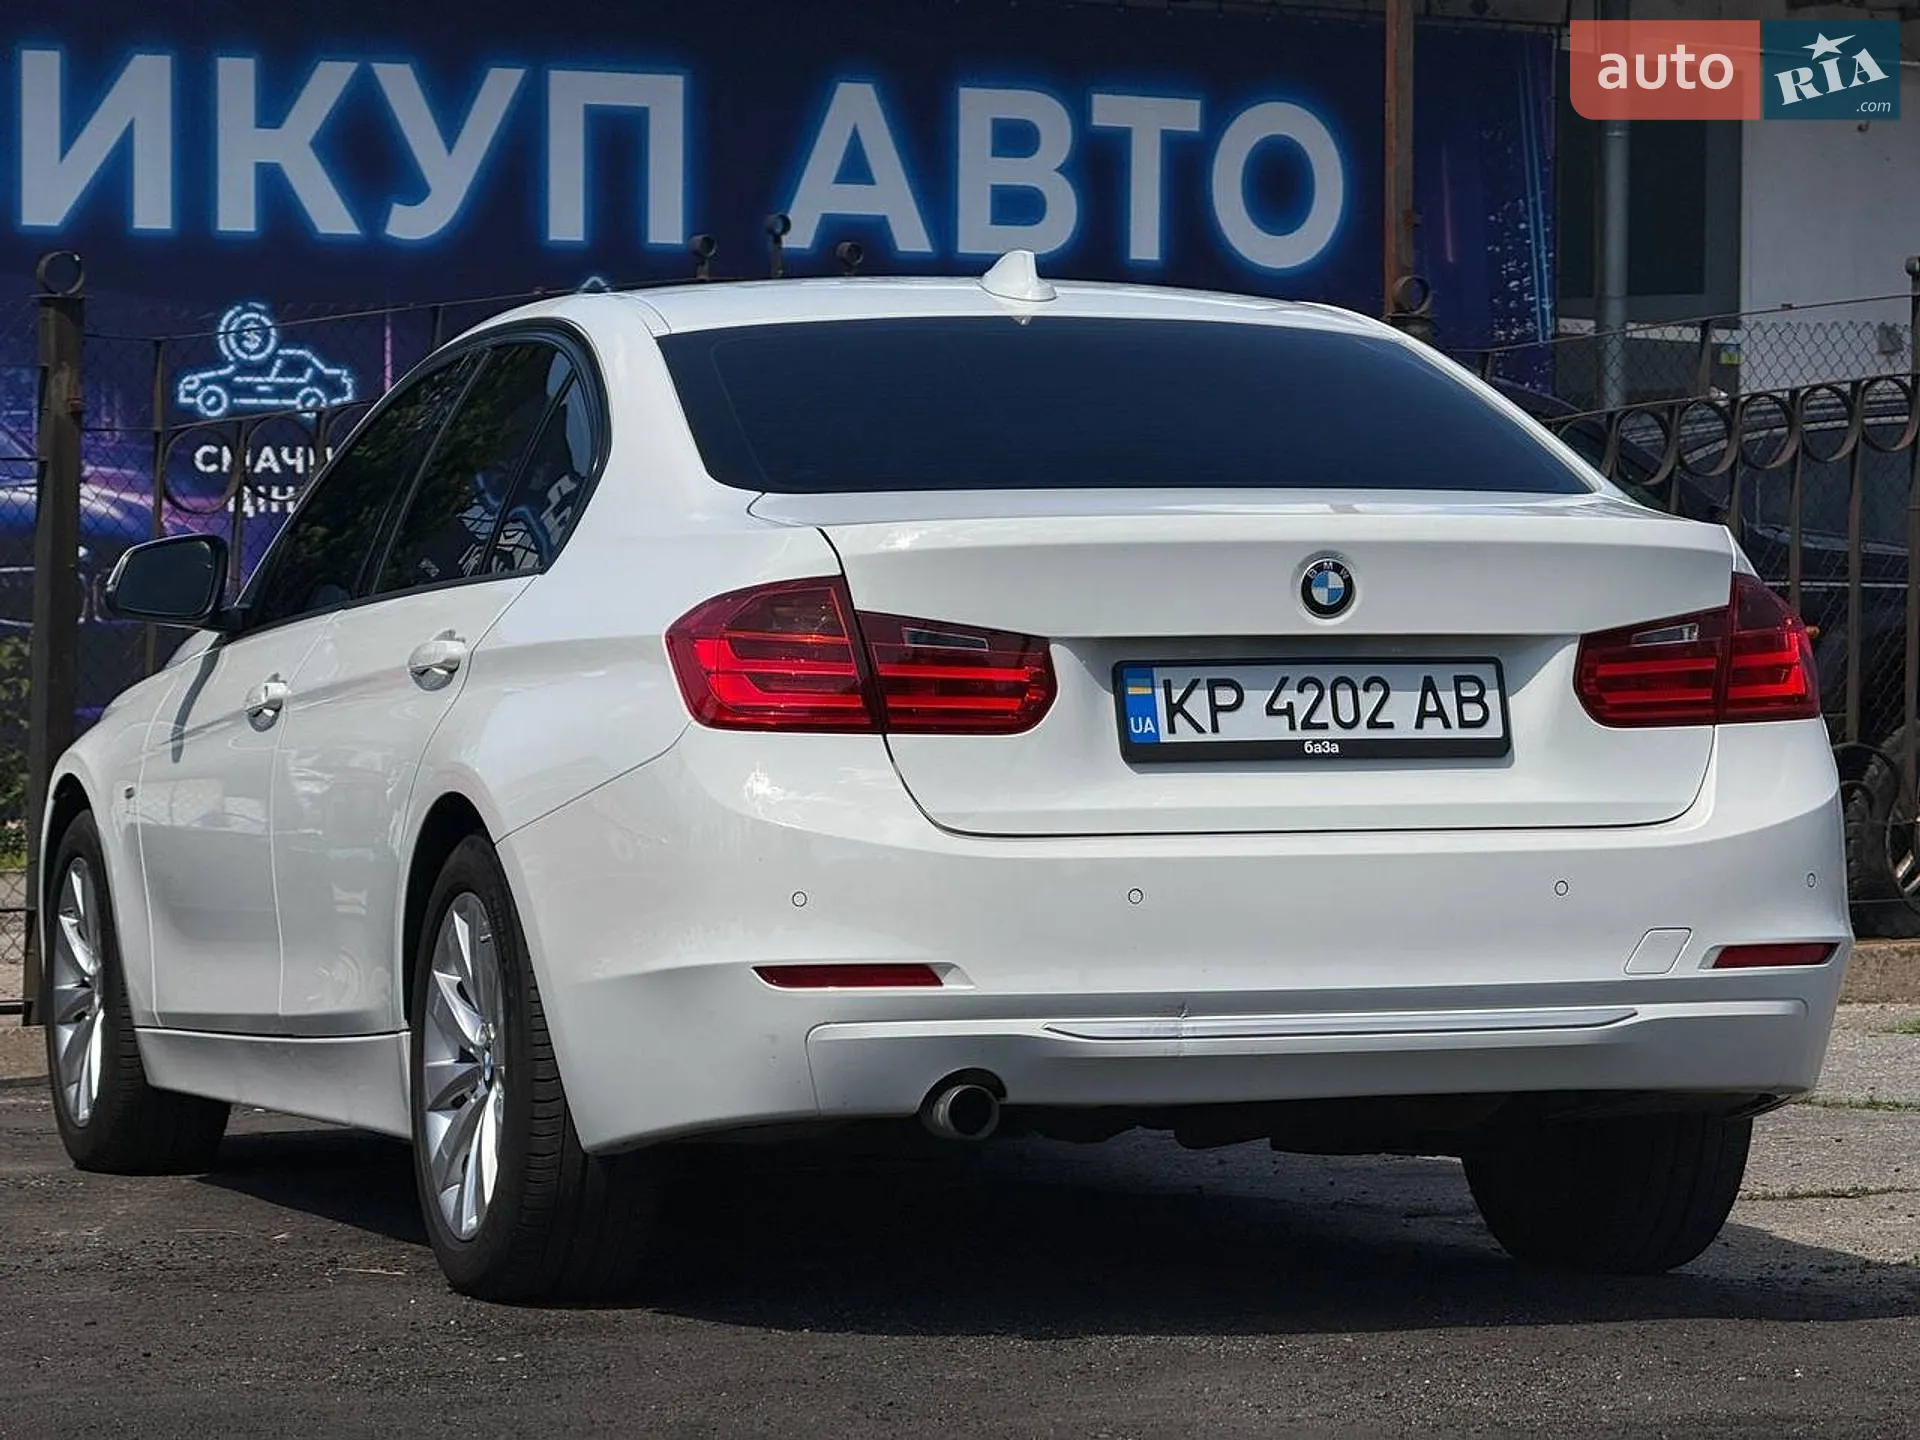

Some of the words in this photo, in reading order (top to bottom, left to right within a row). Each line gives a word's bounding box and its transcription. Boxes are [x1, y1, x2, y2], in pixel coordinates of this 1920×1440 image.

[20, 49, 685, 245] ИКУП
[781, 81, 1344, 269] АВТО
[1307, 562, 1350, 580] BMW
[1162, 677, 1245, 735] KP
[1265, 675, 1395, 732] 4202
[1414, 674, 1491, 730] AB
[1129, 717, 1157, 735] UA
